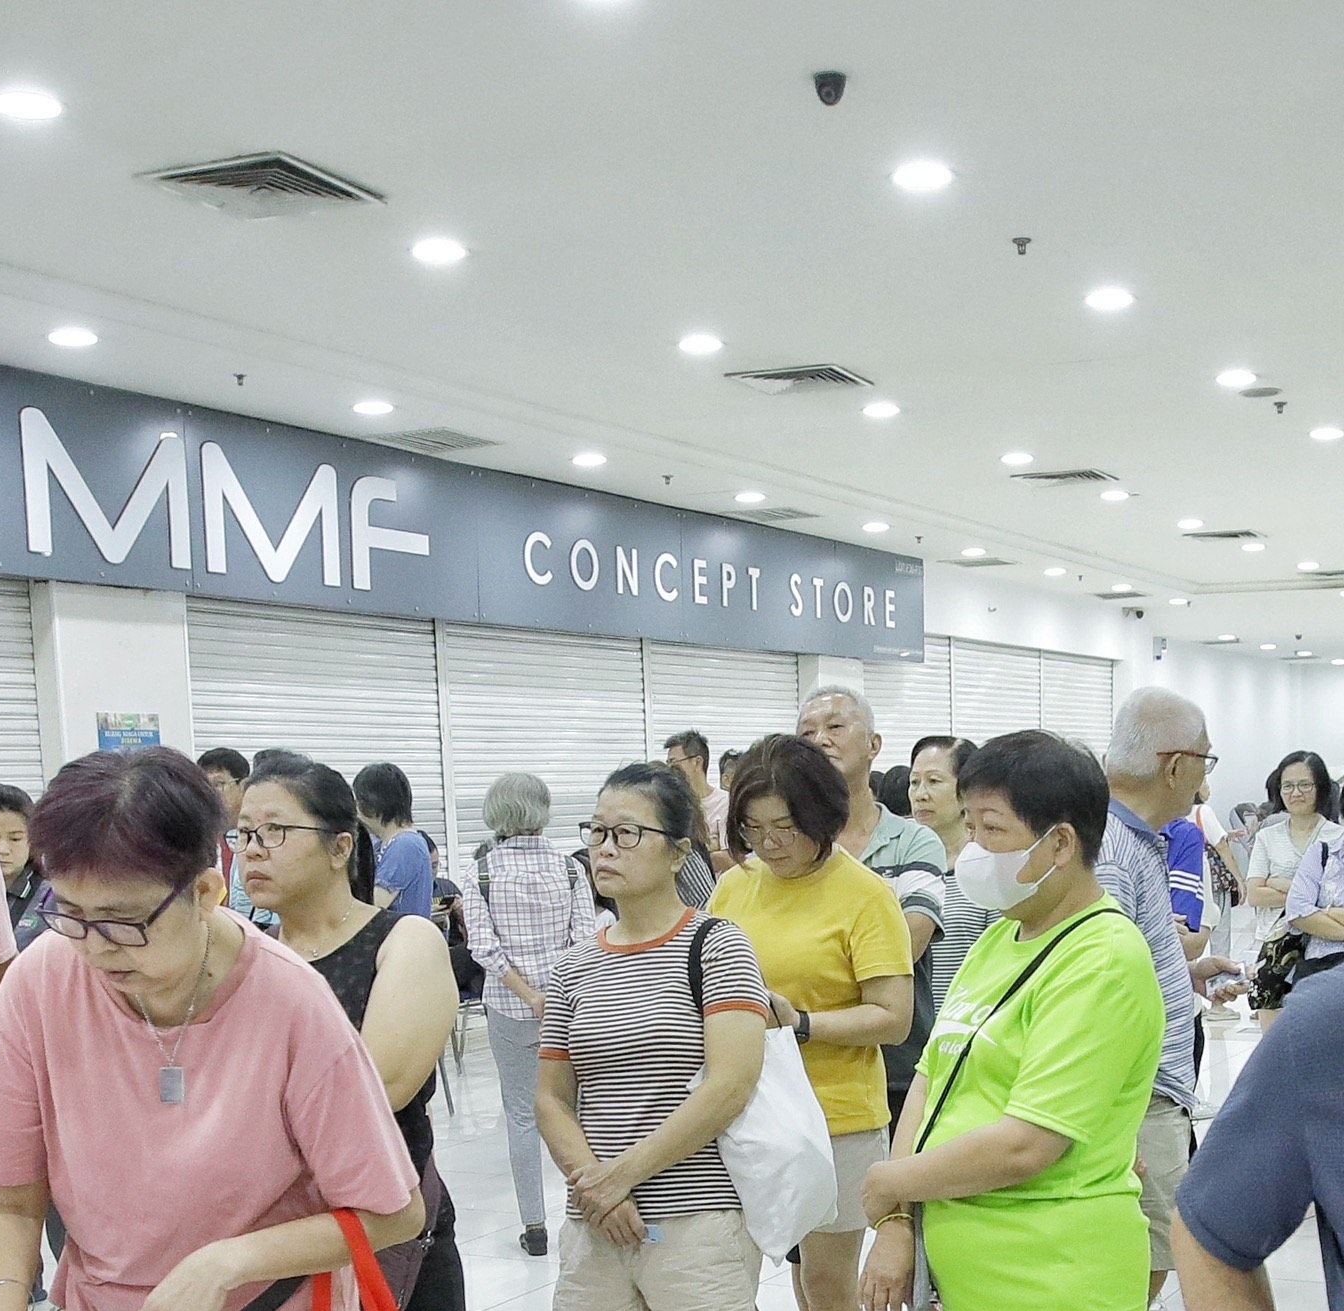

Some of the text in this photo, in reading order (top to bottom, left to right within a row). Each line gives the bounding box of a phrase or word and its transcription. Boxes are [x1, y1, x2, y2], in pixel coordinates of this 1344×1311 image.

[19, 405, 897, 630] MMF CONCEPT STORE
